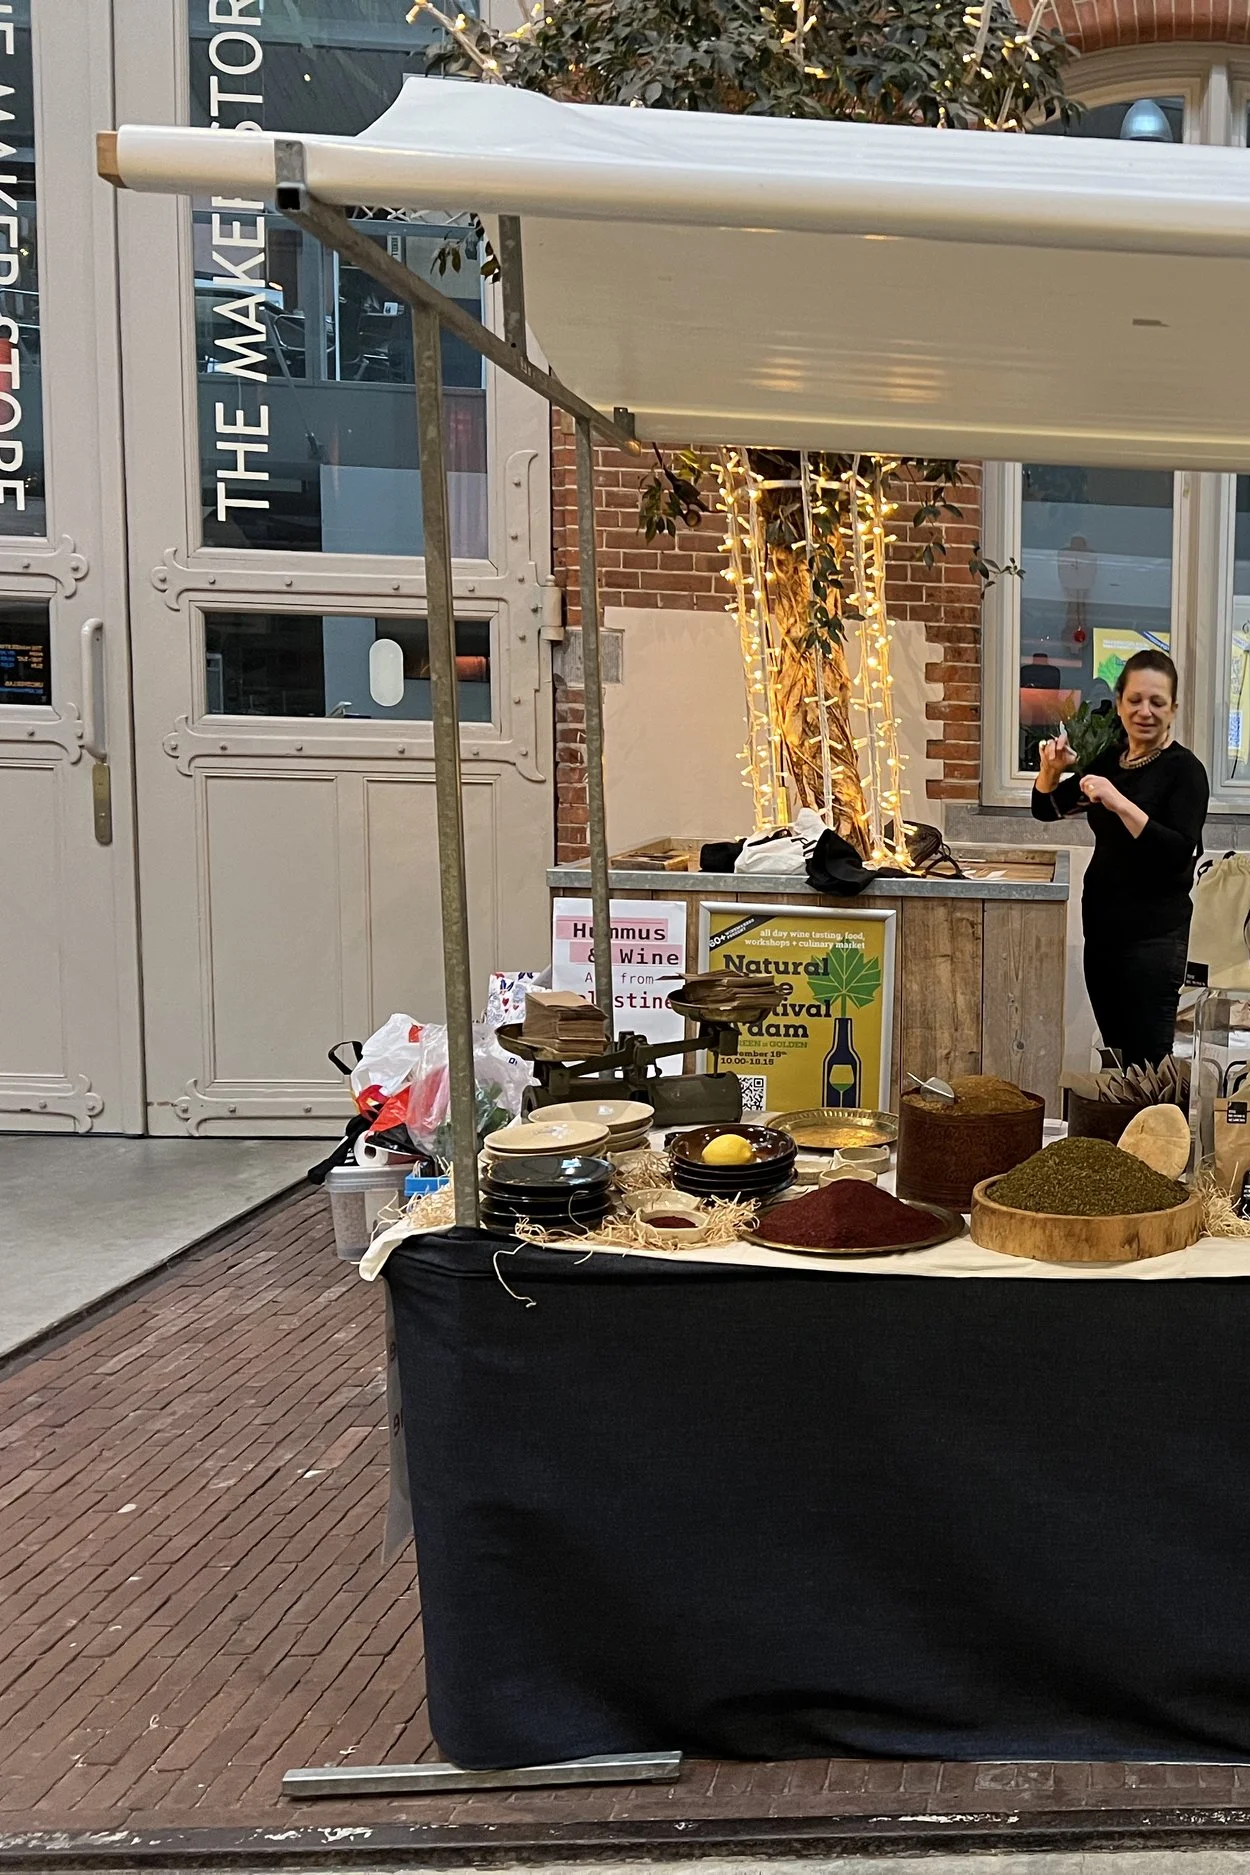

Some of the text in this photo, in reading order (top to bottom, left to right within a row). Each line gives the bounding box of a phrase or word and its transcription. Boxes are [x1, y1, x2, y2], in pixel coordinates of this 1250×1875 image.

[215, 402, 270, 522] THE
[760, 929, 866, 941] all day wine tasting, food,
[744, 938, 791, 948] workshops
[798, 939, 834, 950] culinary
[835, 941, 865, 949] market
[619, 948, 680, 966] Wine
[723, 954, 830, 976] Natural
[621, 972, 655, 985] from
